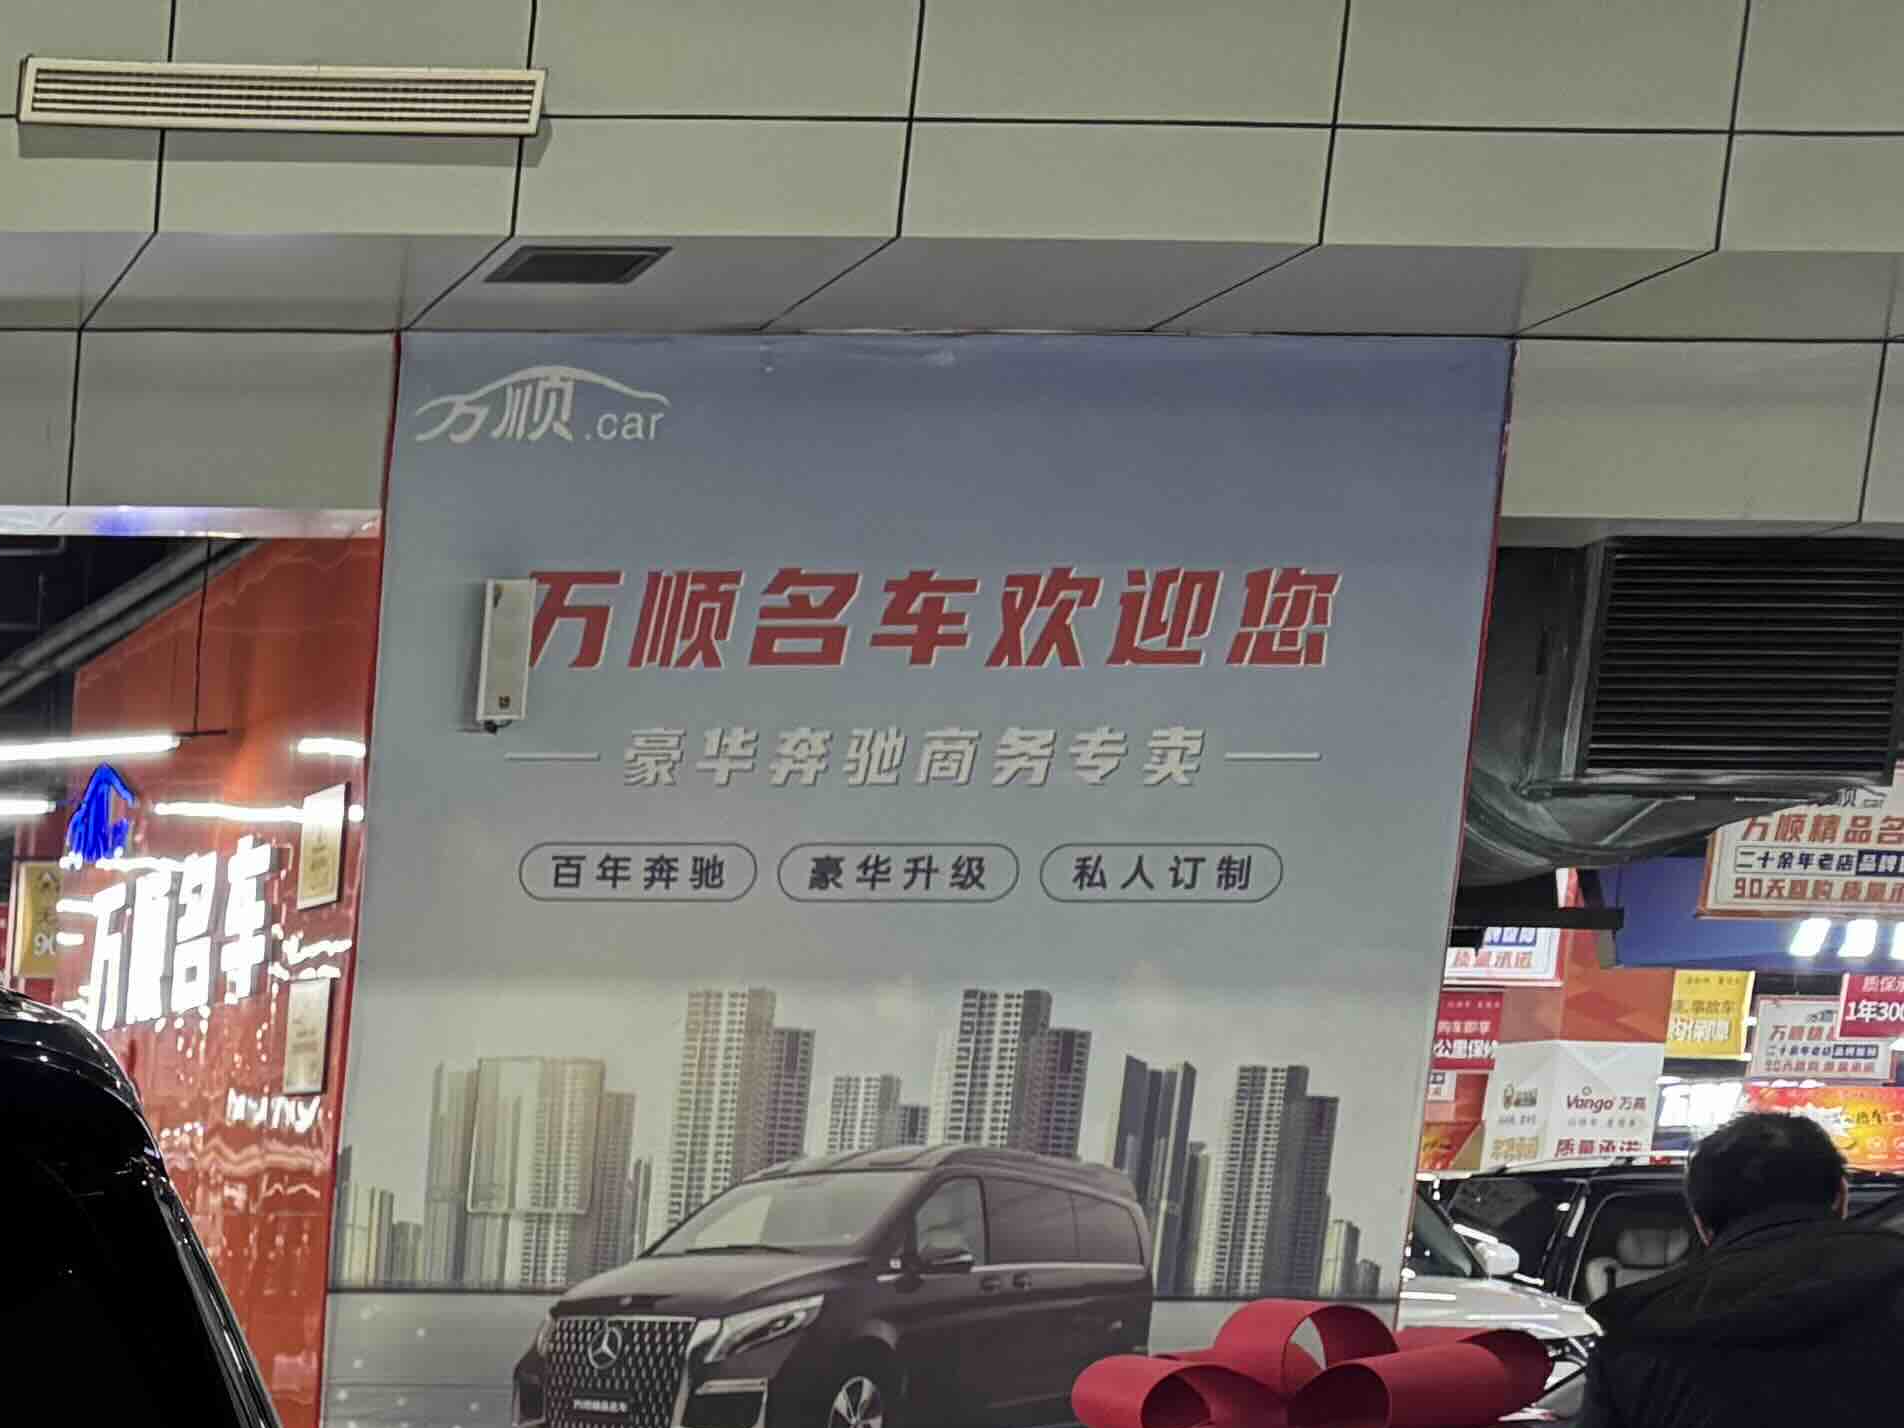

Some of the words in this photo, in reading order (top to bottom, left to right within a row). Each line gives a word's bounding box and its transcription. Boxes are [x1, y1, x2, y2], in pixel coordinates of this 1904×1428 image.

[528, 566, 1342, 670] 万顺名车欢迎您
[623, 727, 1206, 788] 豪华奔驰商务专卖
[551, 852, 728, 892] 百年奔驰
[808, 852, 989, 893] 豪华升级
[1072, 852, 1255, 893] 私人订制
